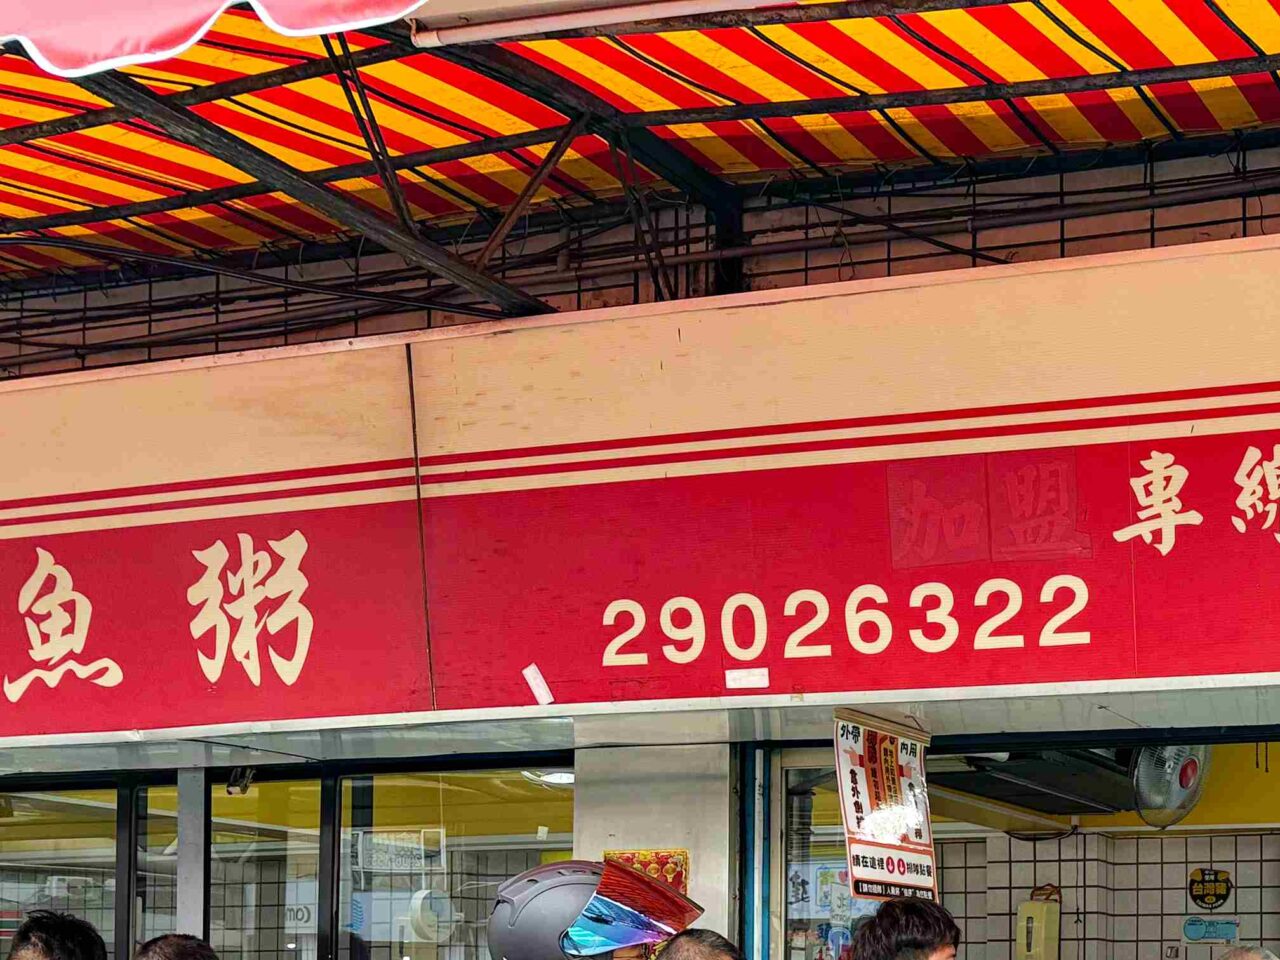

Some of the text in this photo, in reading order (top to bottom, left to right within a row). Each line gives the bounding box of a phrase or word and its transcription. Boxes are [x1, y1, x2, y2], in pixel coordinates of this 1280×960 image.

[4, 530, 314, 703] 魚粥
[602, 574, 1091, 667] 29026322
[840, 723, 861, 744] 外帶
[1192, 882, 1227, 895] 台灣豬
